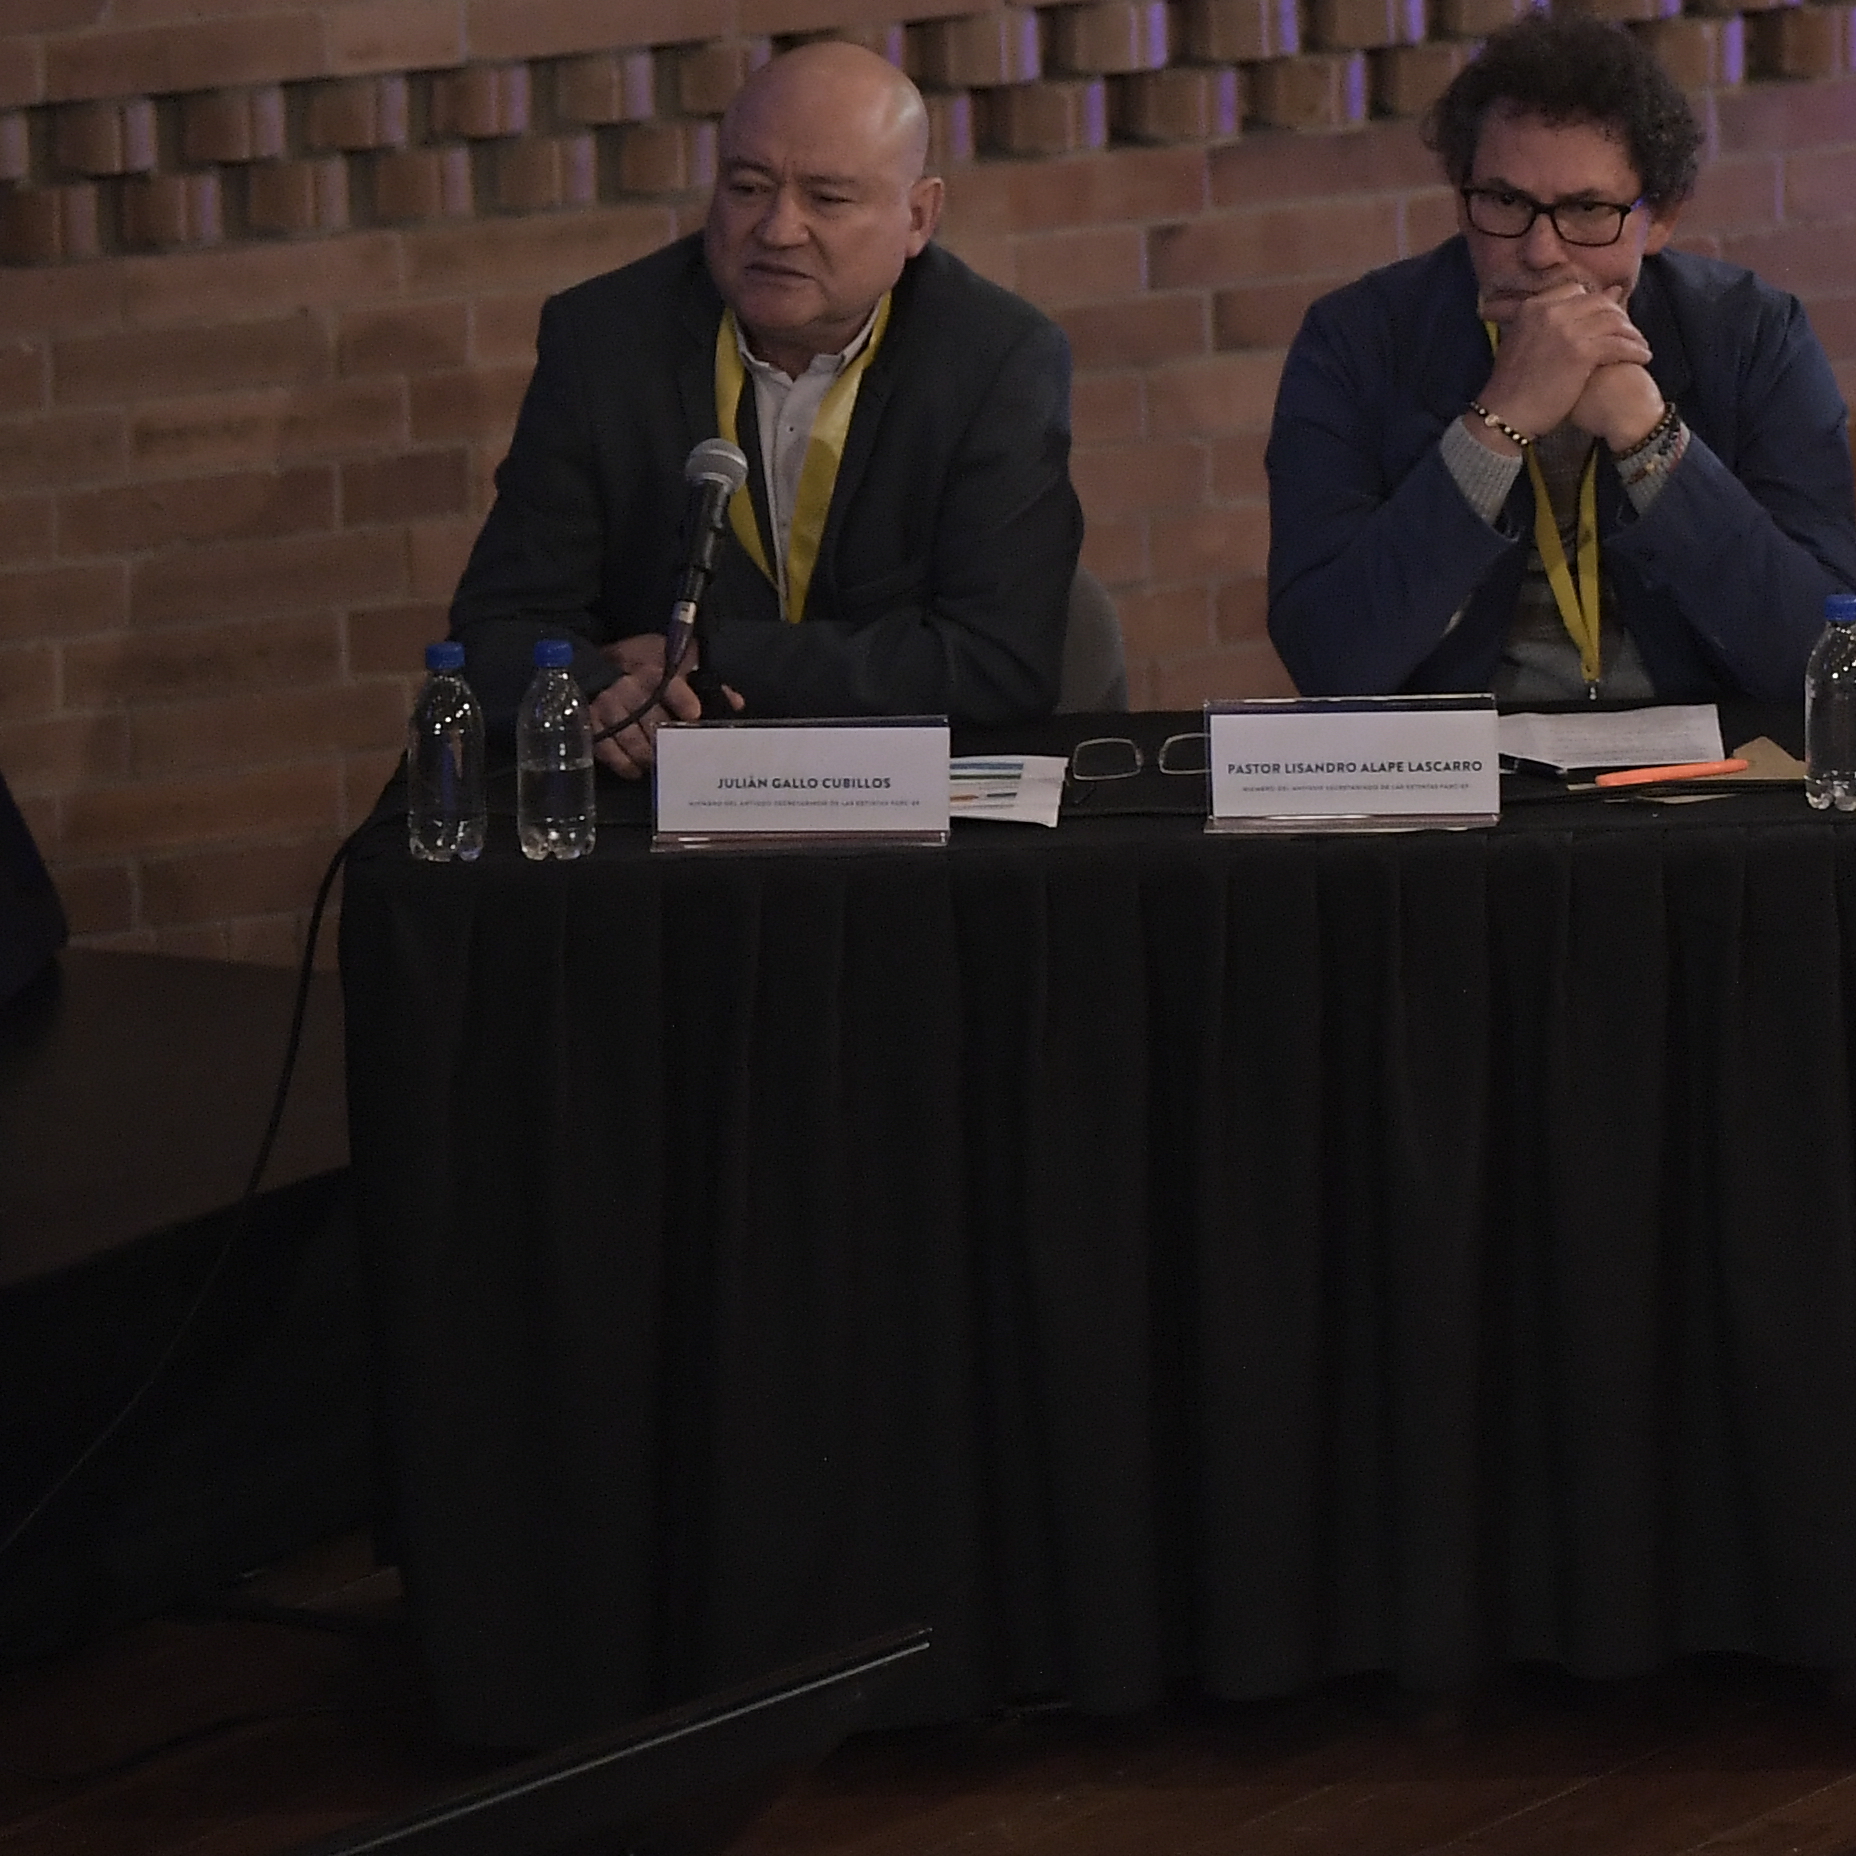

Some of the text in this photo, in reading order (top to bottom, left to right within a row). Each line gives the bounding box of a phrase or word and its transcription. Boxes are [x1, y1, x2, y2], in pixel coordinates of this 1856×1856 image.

[1228, 760, 1482, 774] PASTOR LISANDRO ALAPE LASCARRO
[717, 776, 890, 789] JULIÁN GALLO CUBILLOS
